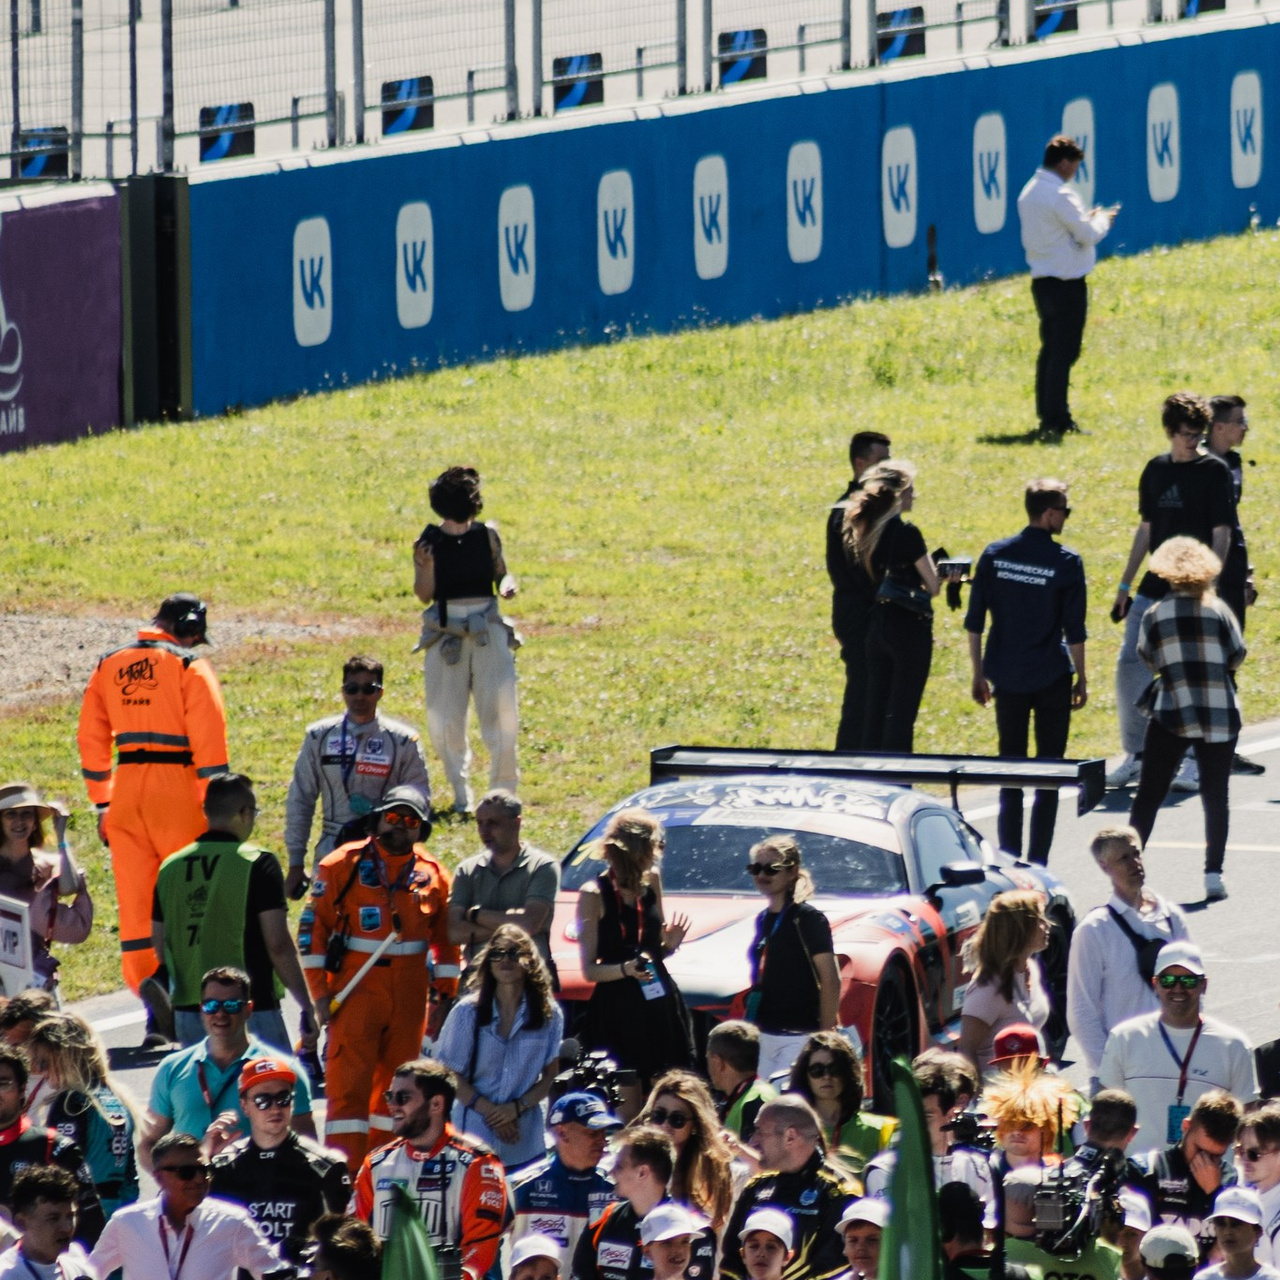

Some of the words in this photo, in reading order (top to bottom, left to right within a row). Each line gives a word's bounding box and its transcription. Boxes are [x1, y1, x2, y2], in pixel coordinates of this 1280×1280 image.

[1152, 120, 1174, 169] VK
[1237, 107, 1257, 156] VK
[888, 163, 910, 214] VK
[979, 151, 1001, 200] VK
[700, 192, 723, 245] VK
[793, 177, 817, 228] VK
[504, 222, 529, 277] VK
[604, 206, 629, 260] VK
[299, 255, 326, 311] VK
[402, 239, 428, 294] VK
[183, 854, 221, 882] TV
[255, 1221, 296, 1238] OLT
